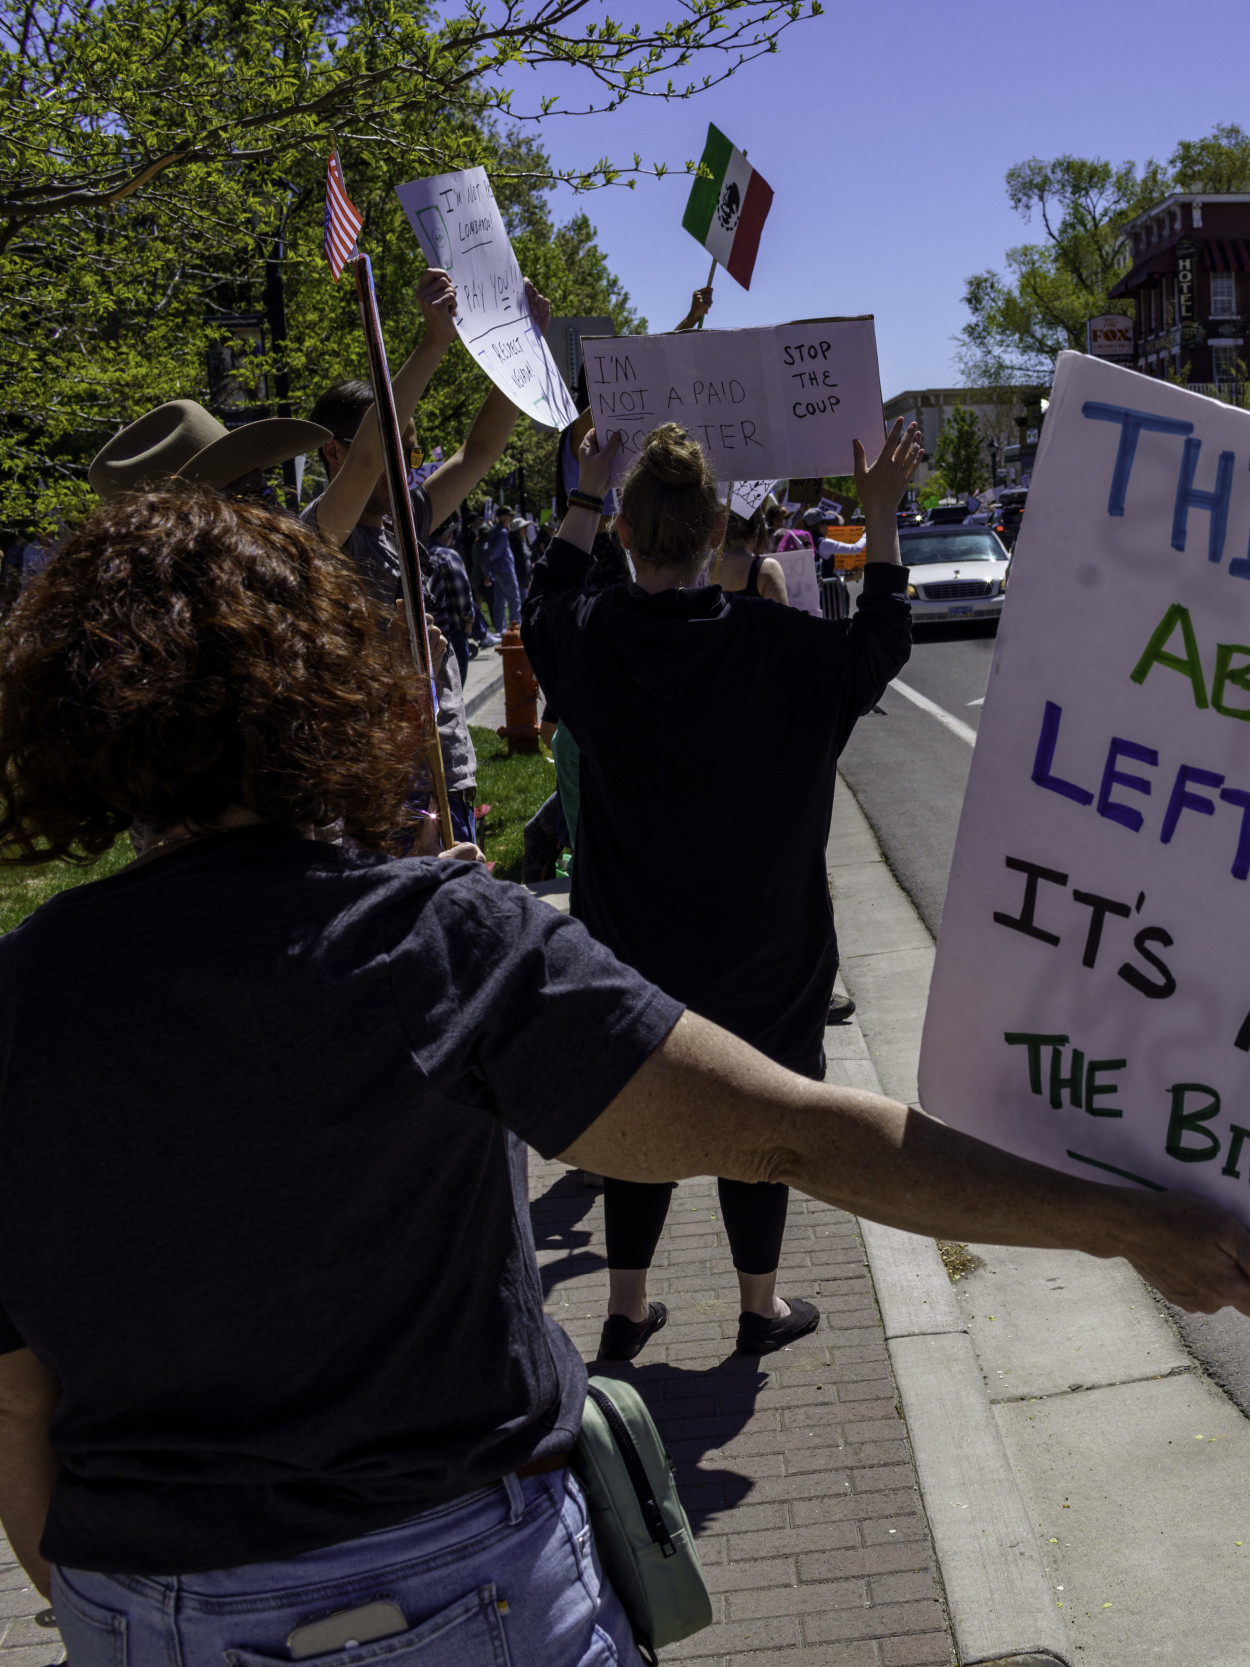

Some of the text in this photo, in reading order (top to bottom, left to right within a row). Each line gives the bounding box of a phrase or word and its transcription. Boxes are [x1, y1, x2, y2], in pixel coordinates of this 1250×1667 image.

[467, 184, 481, 204] NOT
[463, 280, 486, 314] PAY
[1178, 258, 1193, 317] HOTEL
[1092, 327, 1130, 342] FOX
[491, 337, 524, 363] RESPECT
[783, 340, 832, 366] STOP
[594, 355, 637, 384] I'M
[792, 370, 838, 389] THE
[599, 379, 746, 414] NOT A PAID
[792, 395, 841, 419] COUP
[993, 856, 1177, 999] IT'S
[1004, 1031, 1128, 1119] THE
